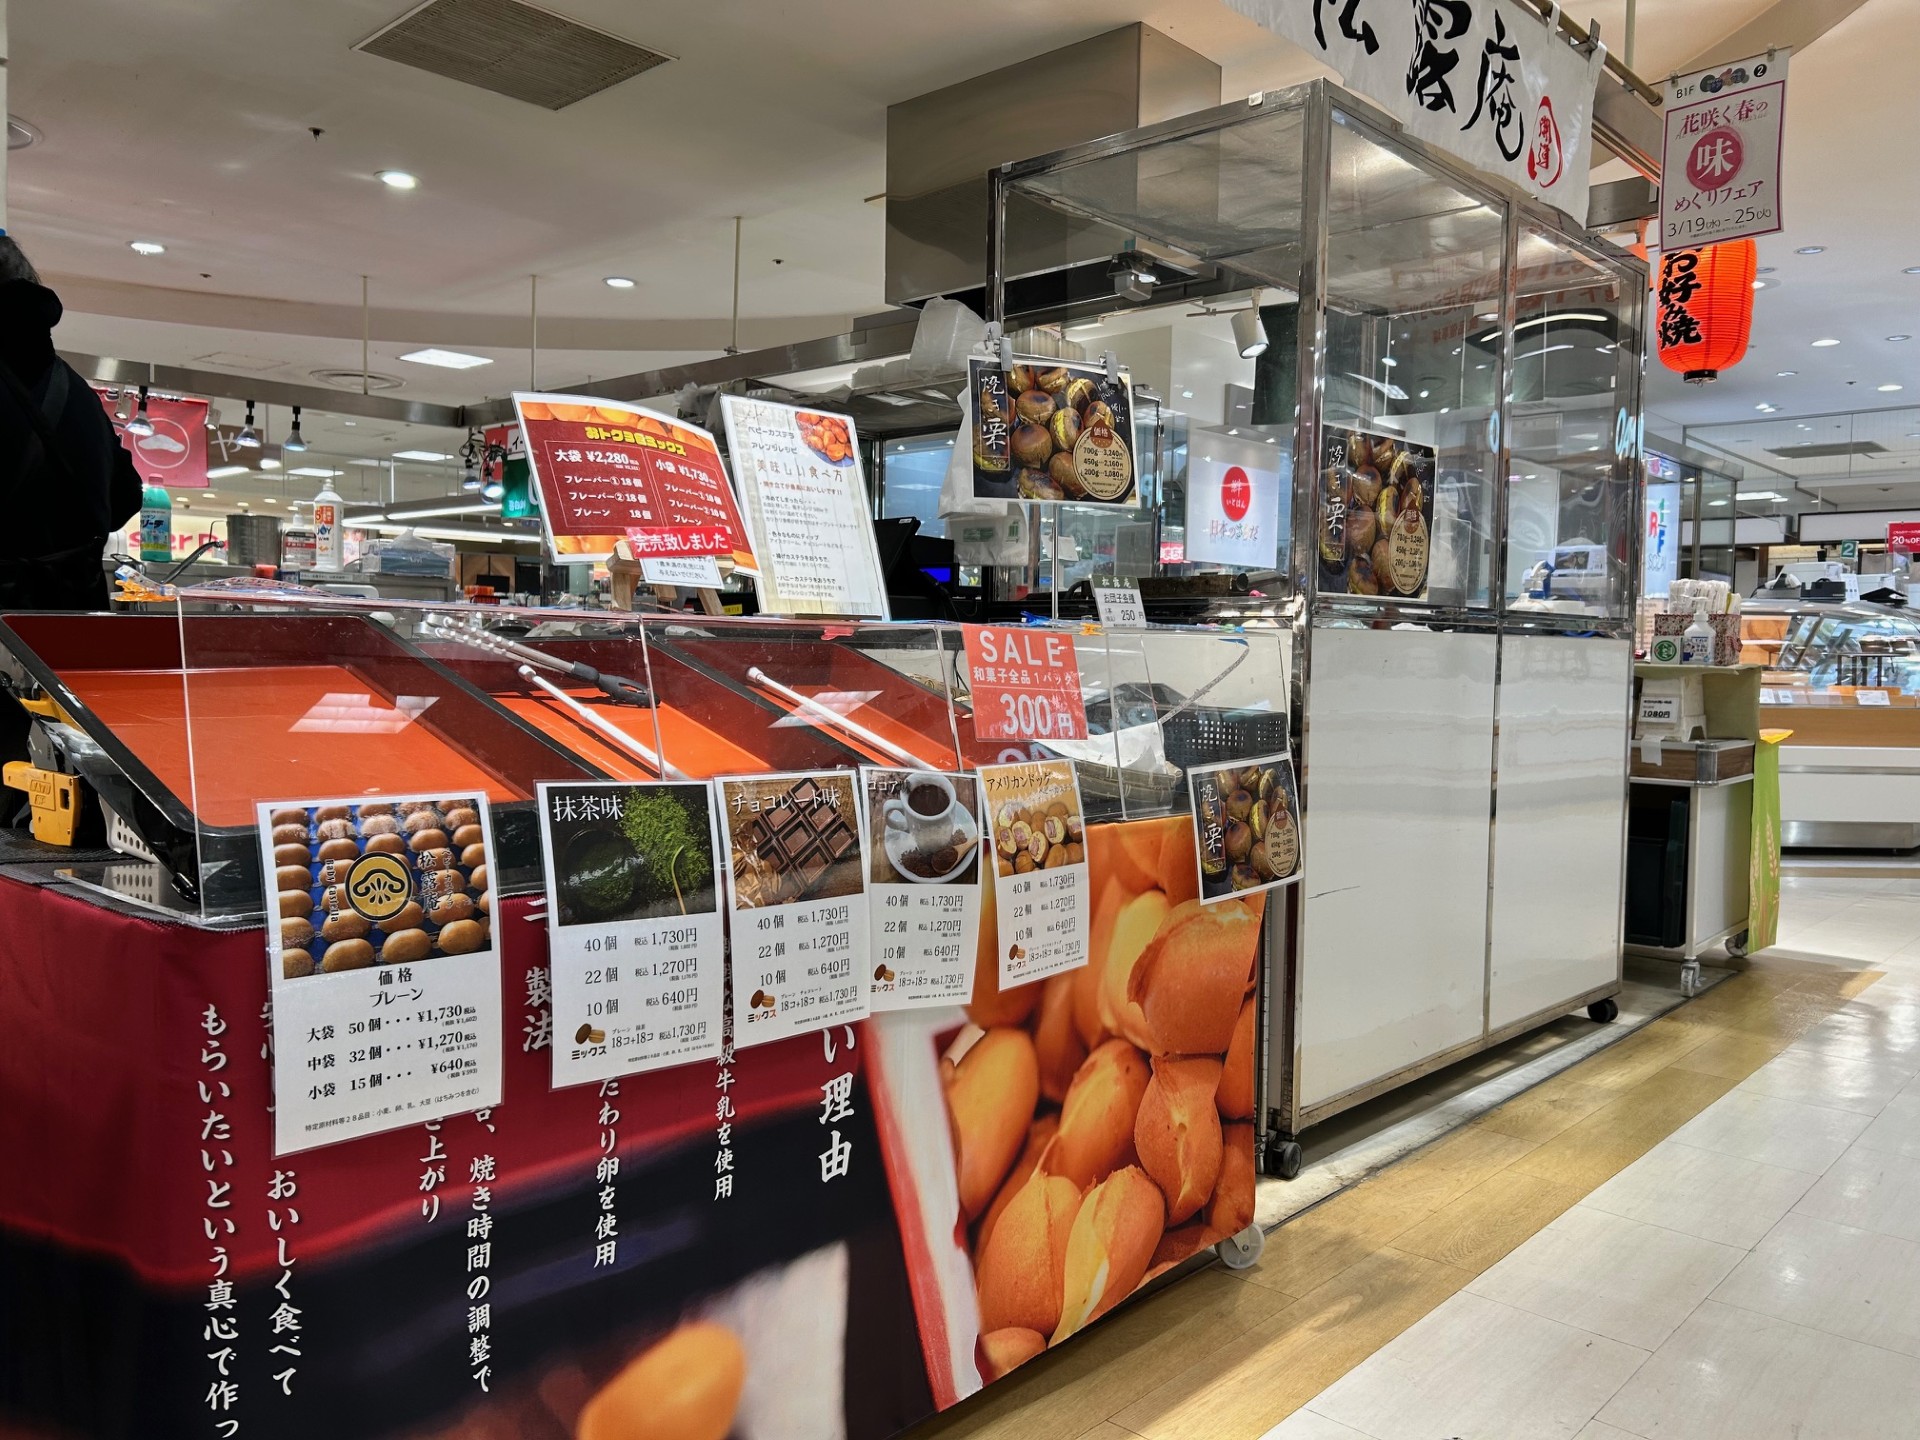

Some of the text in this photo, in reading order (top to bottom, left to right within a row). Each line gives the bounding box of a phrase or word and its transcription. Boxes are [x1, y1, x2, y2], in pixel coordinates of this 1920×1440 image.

[1676, 85, 1695, 99] B1F
[1681, 99, 1768, 136] 花咲く春の
[1696, 138, 1734, 180] 味
[1674, 180, 1764, 212] めぐりフェア
[981, 375, 1007, 450] 焼き栗
[554, 449, 629, 466] 大袋 ¥2,280
[757, 458, 843, 483] 美味しい食べ方
[621, 477, 644, 488] 18個
[655, 459, 709, 483] 小袋 ¥1,730
[625, 493, 648, 504] 18個
[1326, 445, 1346, 535] 焼き栗
[573, 507, 653, 521] プレーン 18個
[673, 514, 702, 526] プレーン
[634, 532, 729, 553] 完売致しました
[1843, 542, 1855, 556] 2
[979, 629, 1064, 668] SALE
[972, 664, 1030, 686] 和菓子全品
[999, 692, 1075, 738] 300円
[1643, 710, 1671, 719] 1080円
[985, 772, 1052, 793] アメリカンドッグ
[552, 795, 625, 823] 抹茶味
[730, 785, 842, 814] チョコレート味
[1200, 784, 1222, 853] 焼き栗
[418, 850, 441, 914] 松露庵
[1012, 881, 1031, 894] 40個
[1049, 872, 1075, 888] 1,730円
[885, 893, 909, 908] 40個
[931, 895, 964, 908] 1,730円
[1013, 904, 1032, 918] 22個
[1050, 894, 1075, 911] 1,270円
[756, 914, 785, 930] 40個
[810, 905, 849, 923] 1,730円
[884, 920, 907, 933] 22個
[930, 920, 962, 932] 1,270円
[1015, 926, 1033, 942] 10個
[1055, 917, 1076, 931] 640円
[583, 934, 618, 953] 40個
[651, 927, 698, 946] 1,730円
[757, 941, 786, 958] 22個
[812, 931, 849, 950] 1,270円
[882, 946, 906, 959] 10個
[934, 944, 960, 957] 640円
[378, 967, 413, 986] 価格
[584, 966, 618, 985] 22個
[652, 957, 698, 977] 1,270円
[760, 968, 787, 986] 10個
[820, 958, 850, 975] 640円
[1007, 960, 1027, 973] ミックス
[870, 983, 895, 993] ミックス
[939, 973, 965, 986] 1,730円
[369, 988, 424, 1008] プレーン
[585, 998, 619, 1017] 10個
[661, 987, 698, 1006] 640円
[747, 1009, 777, 1023] ミックス
[780, 997, 815, 1012] 18コ+18コ
[829, 985, 858, 1002] 1,730円
[306, 1024, 335, 1043] 大袋
[417, 1004, 462, 1024] ¥1,730
[308, 1053, 336, 1072] 中袋
[418, 1031, 463, 1050] ¥1,270
[571, 1045, 608, 1061] ミックス
[611, 1031, 654, 1049] 18コ+18コ
[672, 1021, 707, 1039] 1,730円
[308, 1082, 336, 1100] 小袋
[431, 1057, 463, 1075] ¥640
[818, 1024, 856, 1184] い理由
[198, 1003, 239, 1439] もらいたいという真心で作っ
[267, 1169, 302, 1396] おいしく食べて
[468, 1154, 496, 1392] 焼き時間の調整で
